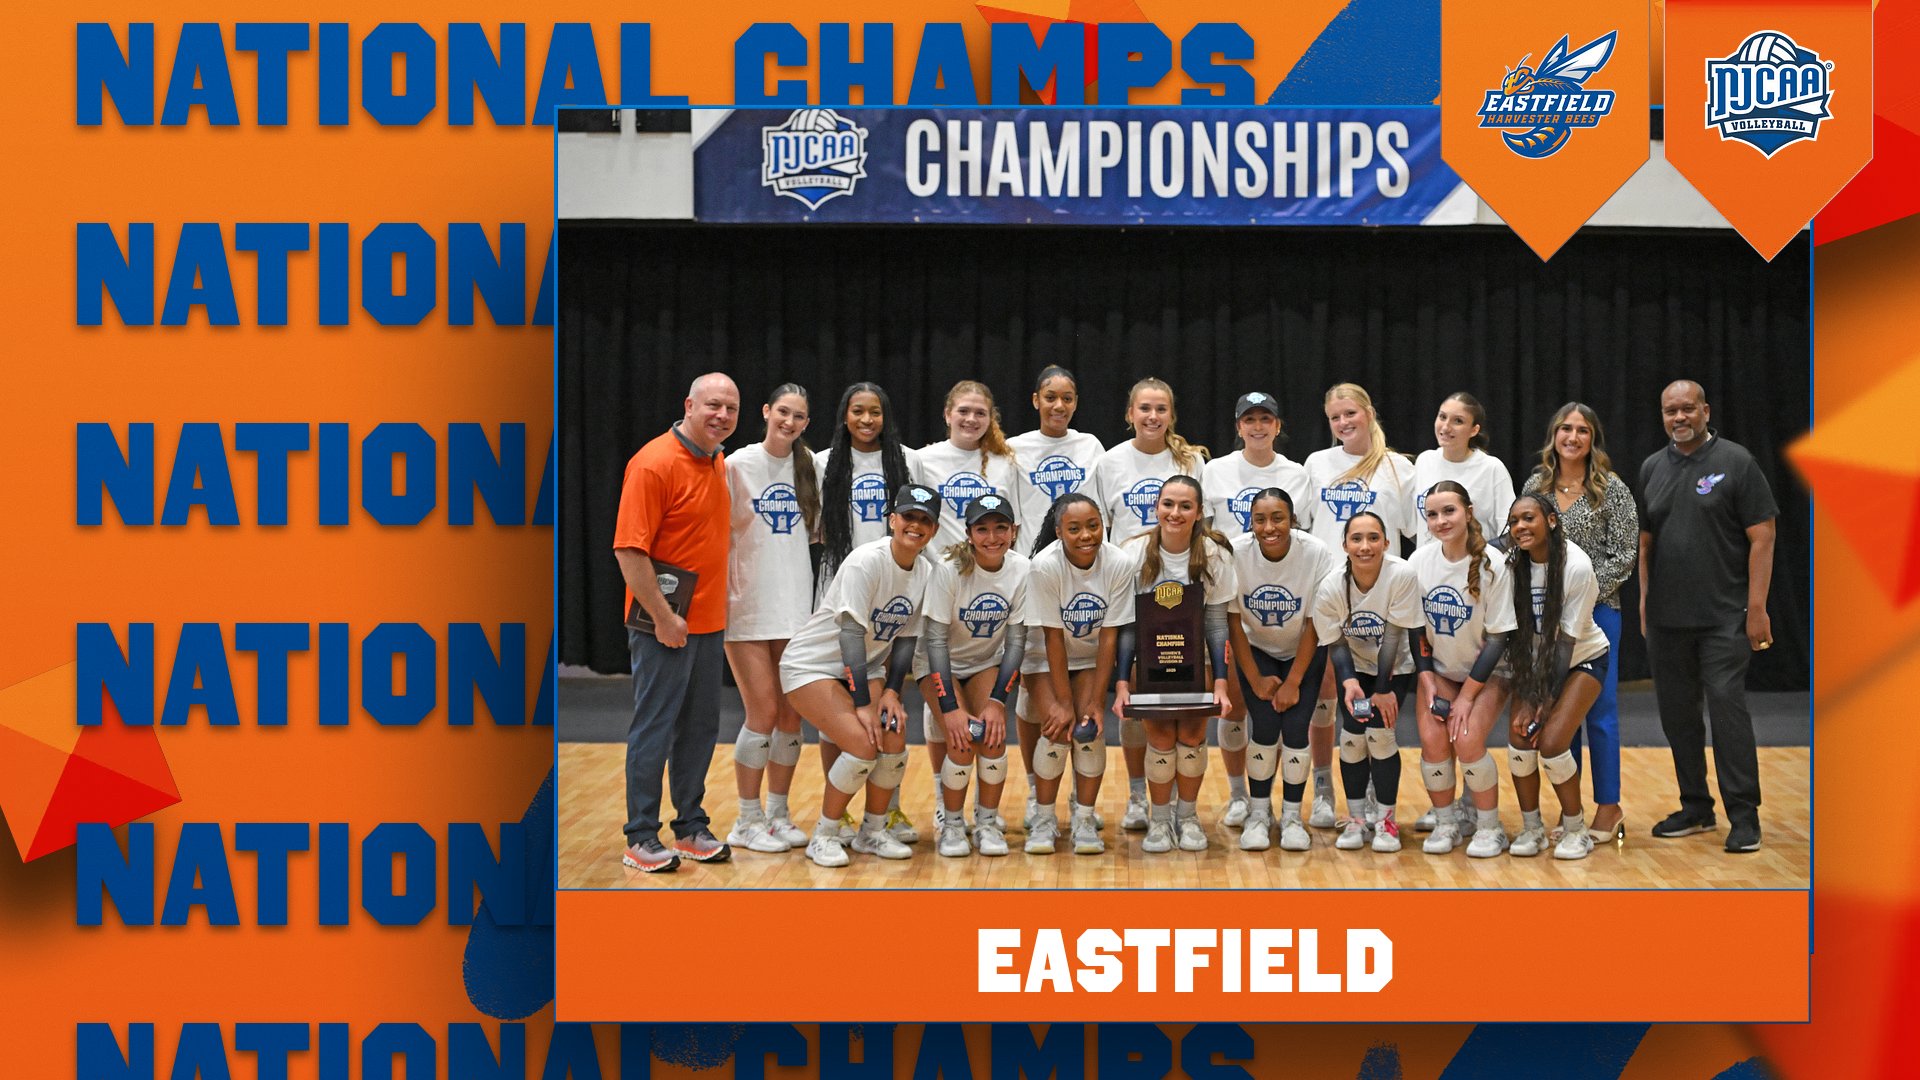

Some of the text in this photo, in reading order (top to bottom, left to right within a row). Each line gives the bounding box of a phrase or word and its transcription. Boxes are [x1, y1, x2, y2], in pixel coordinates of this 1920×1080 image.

[772, 135, 854, 174] NJCAA
[905, 118, 1410, 199] CHAMPIONSHIPS
[784, 175, 844, 188] VOLLEYBALL
[1034, 469, 1082, 484] CHAMPIONS
[852, 489, 885, 501] HAMPIO
[943, 486, 991, 498] CHAMPIONS
[1325, 489, 1371, 503] CHAMPIONS
[759, 500, 800, 512] CHAMPION
[1128, 493, 1159, 506] CHAMP
[1248, 597, 1297, 611] CHAMPIONS
[1424, 599, 1467, 619] CHAMPIONS
[1342, 624, 1385, 636] CHAMPION
